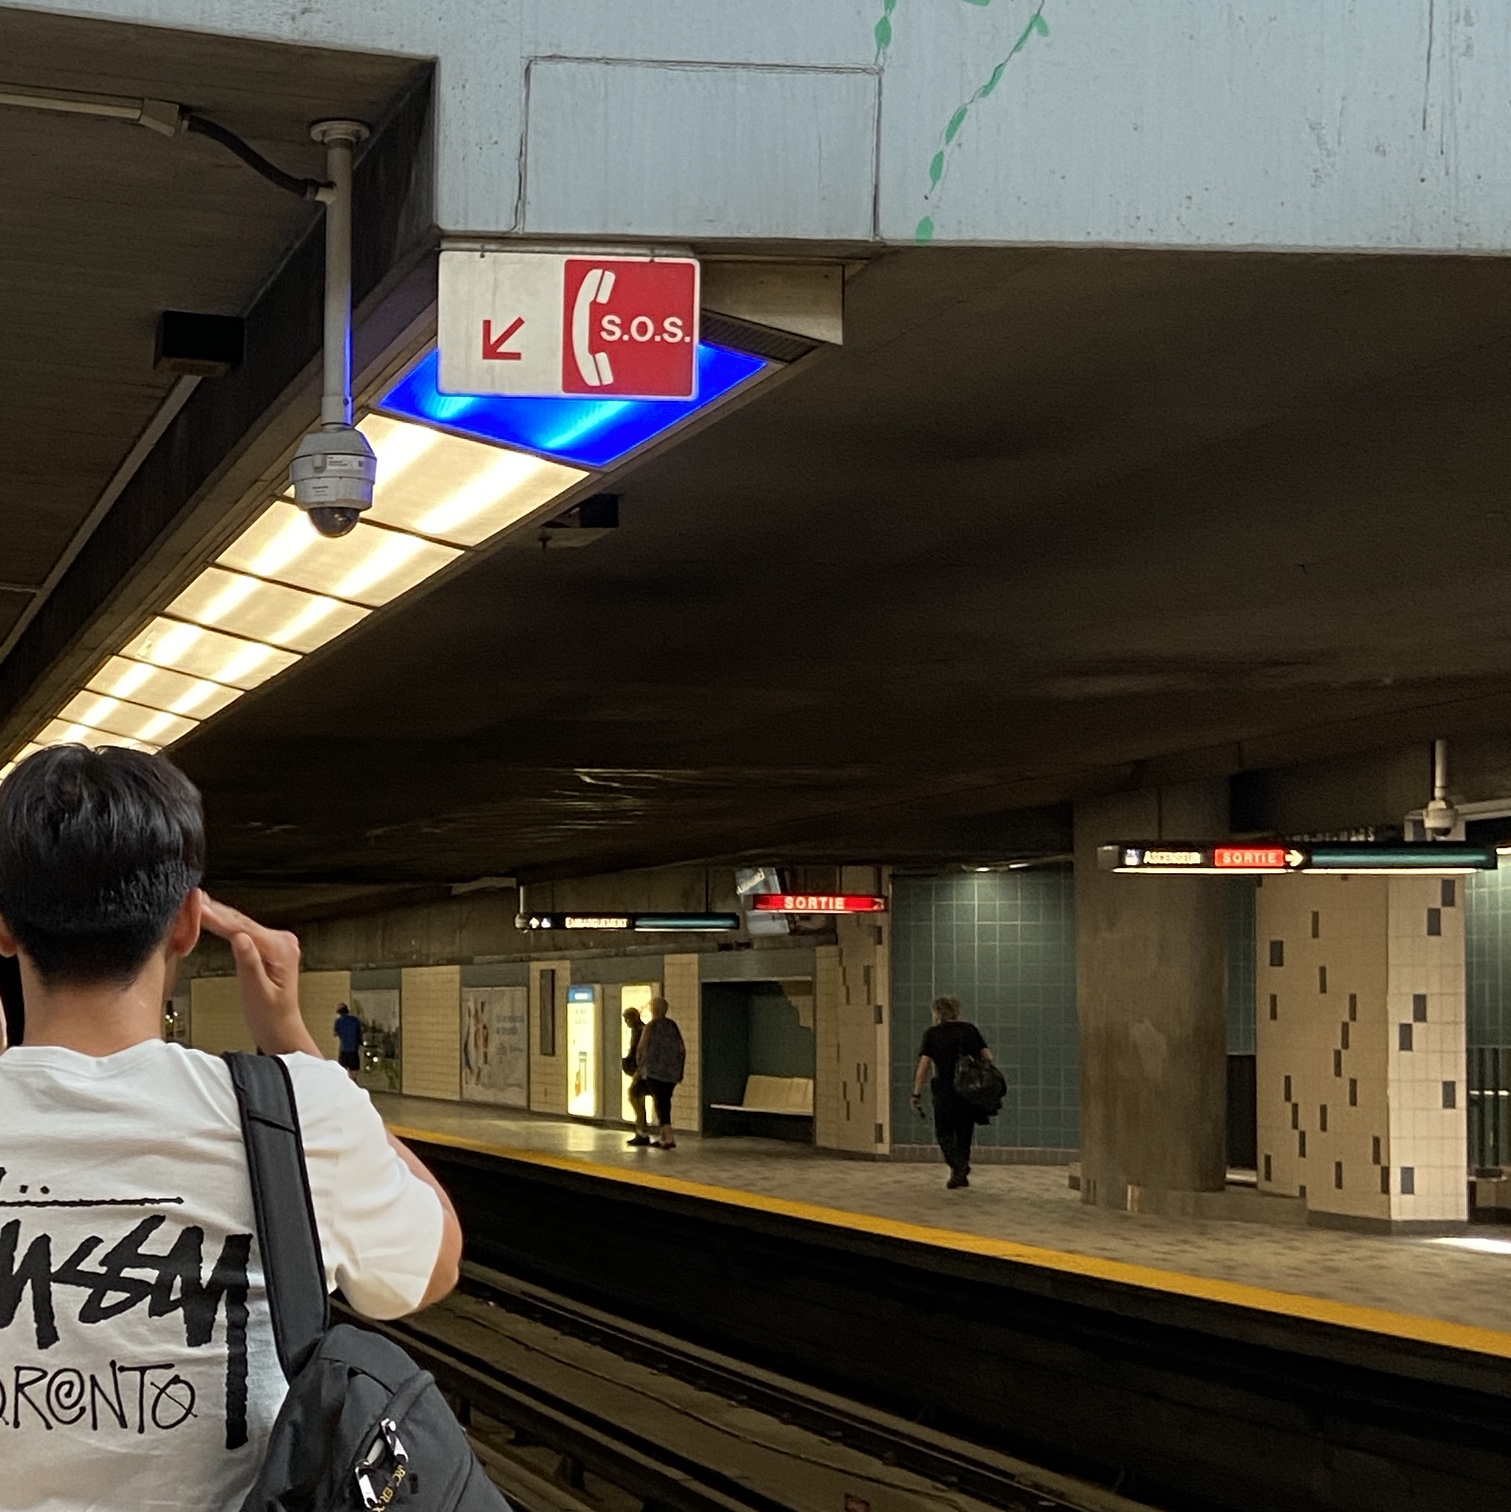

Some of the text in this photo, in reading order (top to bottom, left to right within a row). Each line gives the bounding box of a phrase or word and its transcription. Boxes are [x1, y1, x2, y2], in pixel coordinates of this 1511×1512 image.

[600, 314, 691, 343] S.O.S.
[1222, 852, 1277, 864] SORTIE
[784, 896, 845, 910] SORTIE
